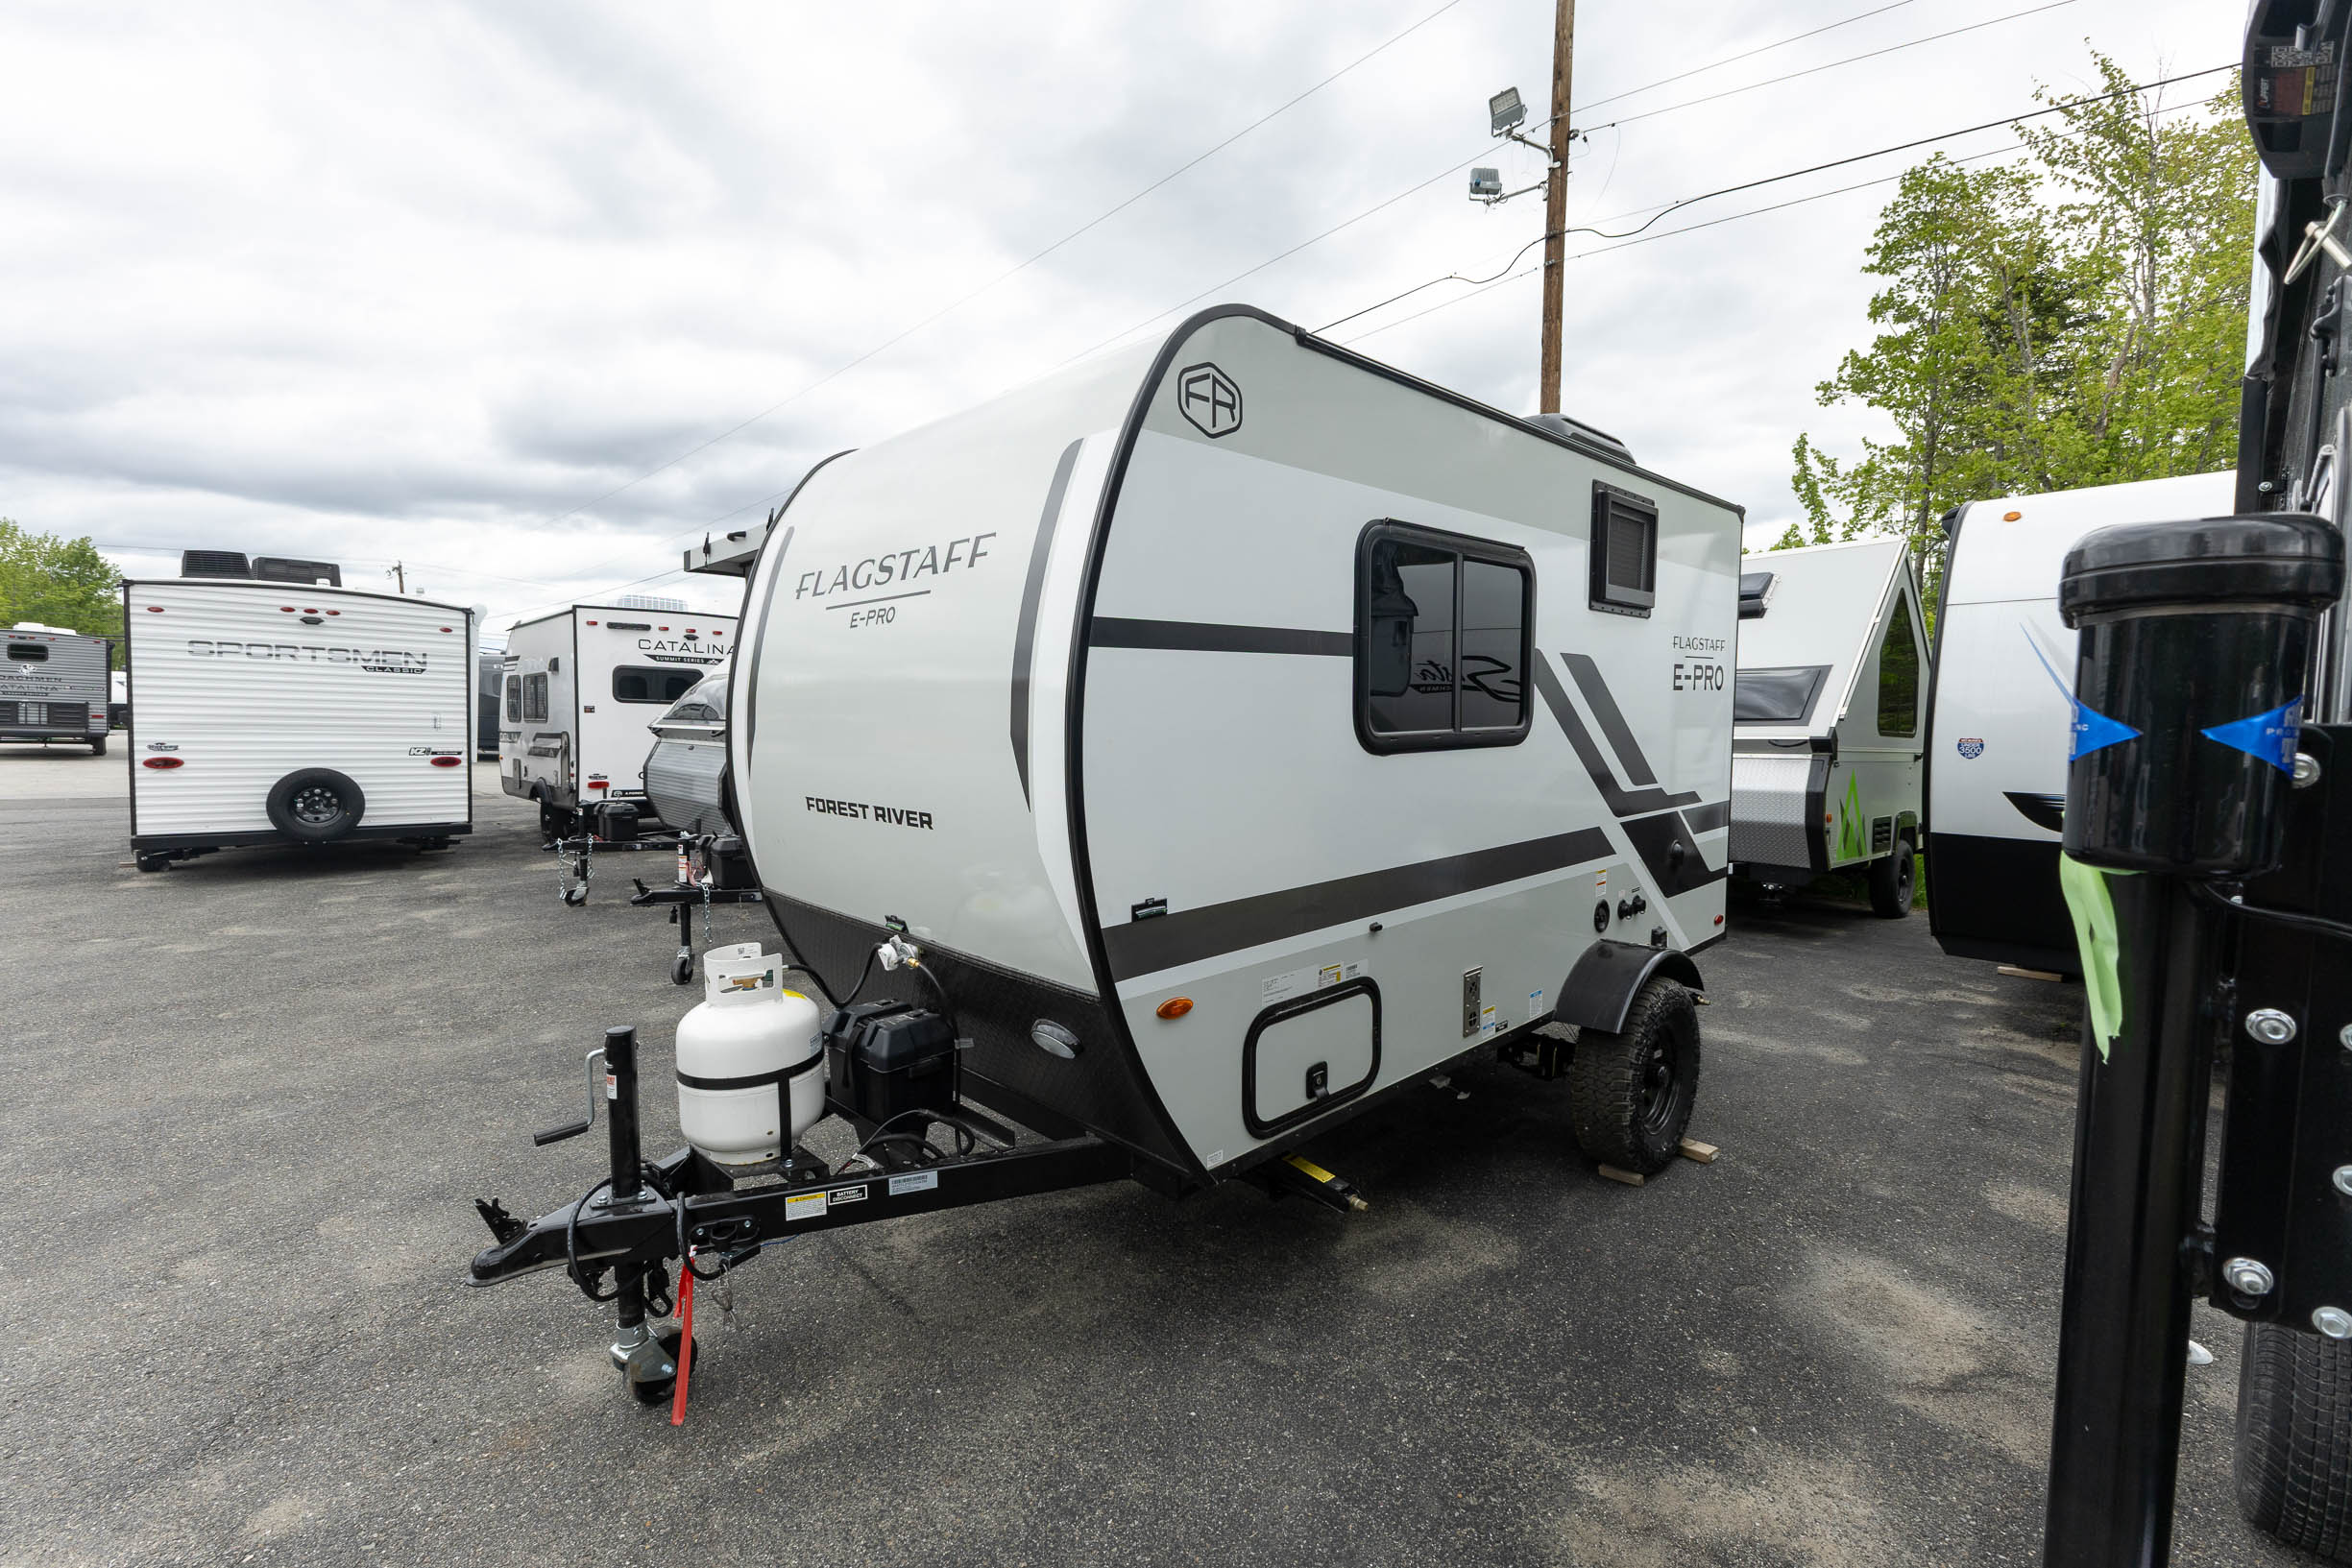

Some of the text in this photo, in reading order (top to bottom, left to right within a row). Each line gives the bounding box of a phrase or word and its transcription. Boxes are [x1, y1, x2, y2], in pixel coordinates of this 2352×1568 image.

[795, 532, 997, 600] FLAGSTAFF
[850, 606, 896, 629] E-PRO
[187, 639, 428, 667] SPORTSMEN
[1673, 636, 1726, 652] FLAGSTAFF
[365, 666, 423, 675] CLASSIC
[1673, 663, 1724, 691] E-PRO
[806, 796, 934, 831] FOREST RIVER
